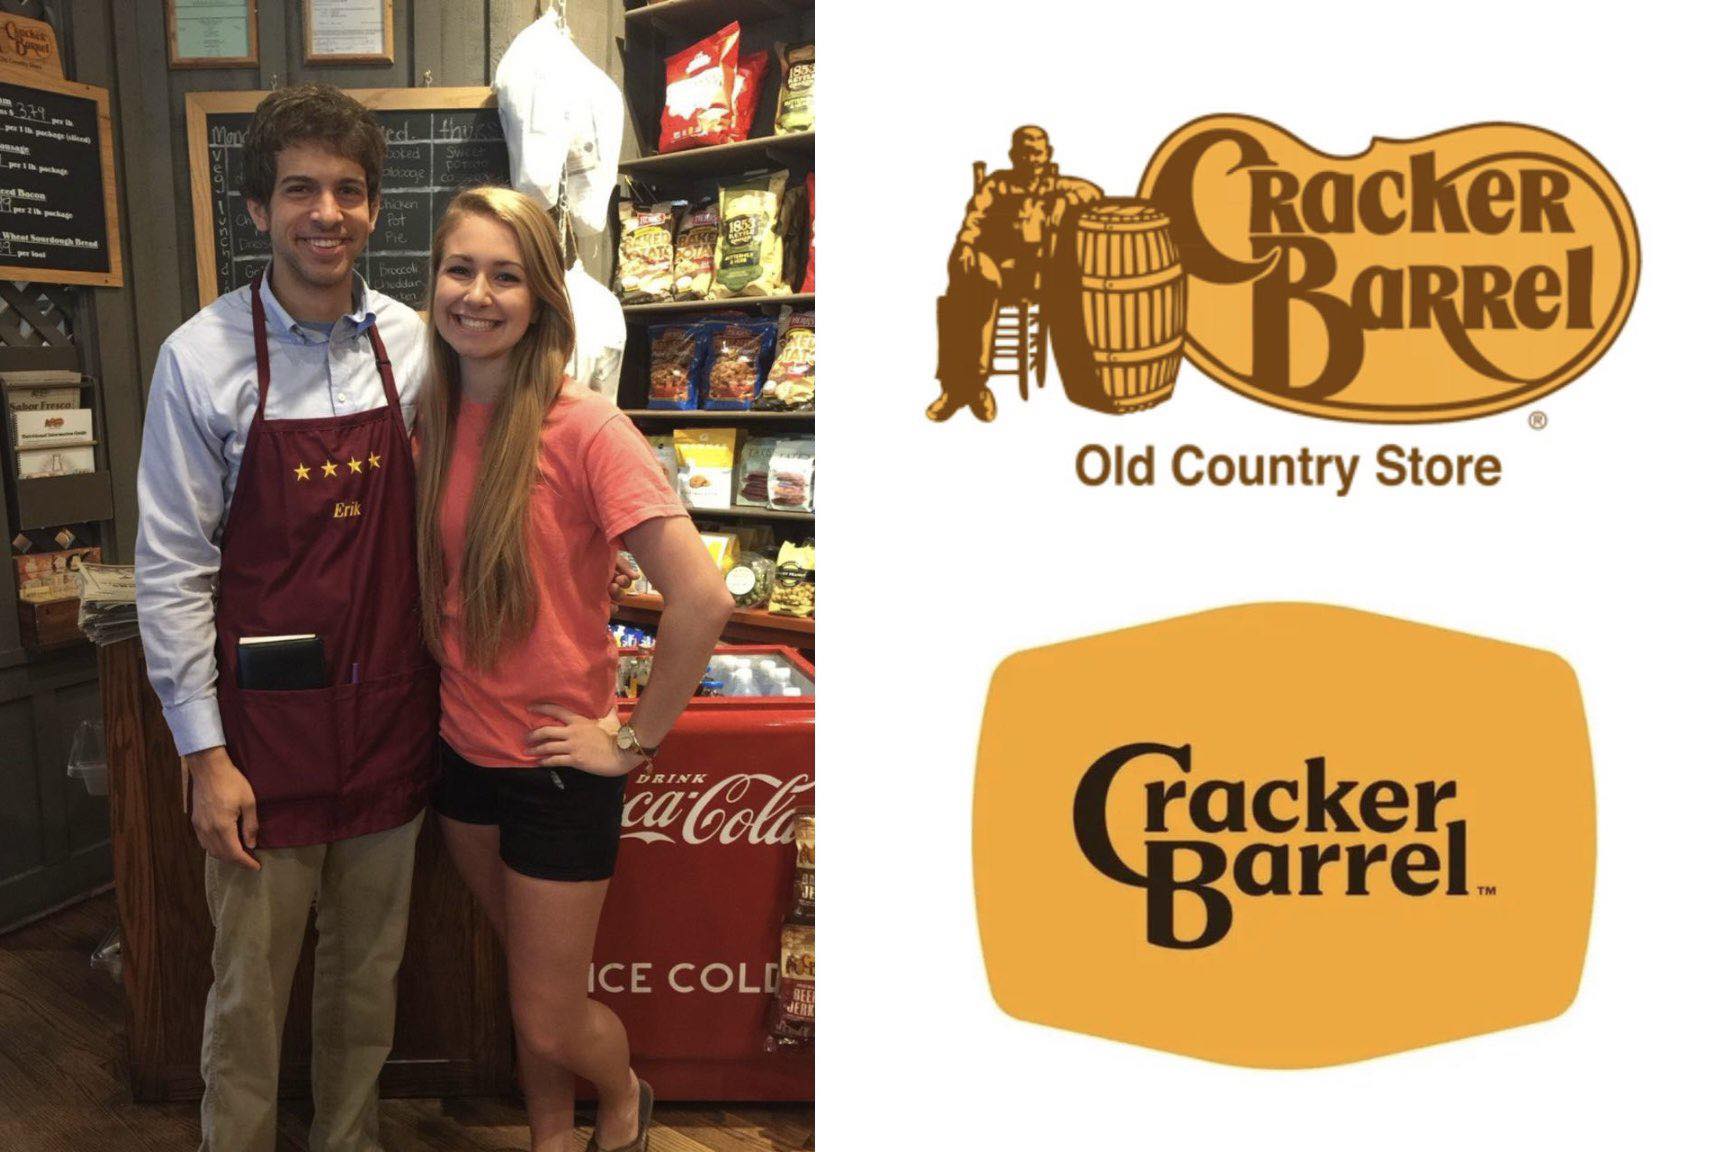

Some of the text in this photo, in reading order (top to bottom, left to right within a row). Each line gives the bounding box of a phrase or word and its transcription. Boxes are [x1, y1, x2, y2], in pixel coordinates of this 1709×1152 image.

[36, 130, 65, 140] package
[381, 121, 416, 142] ed.
[0, 144, 30, 155] ausage
[39, 166, 69, 177] package
[18, 188, 46, 200] Bacon
[44, 210, 73, 220] package
[2, 231, 98, 249] Wheat Sourdough Bread
[40, 401, 72, 410] Fresco
[1075, 443, 1502, 498] Old Country Store
[333, 501, 362, 518] Erik
[636, 773, 708, 784] DRINK
[620, 773, 814, 845] ca-Cola
[1072, 742, 1457, 888] Cracker
[1144, 841, 1470, 950] Barrel
[587, 962, 652, 994] ICE
